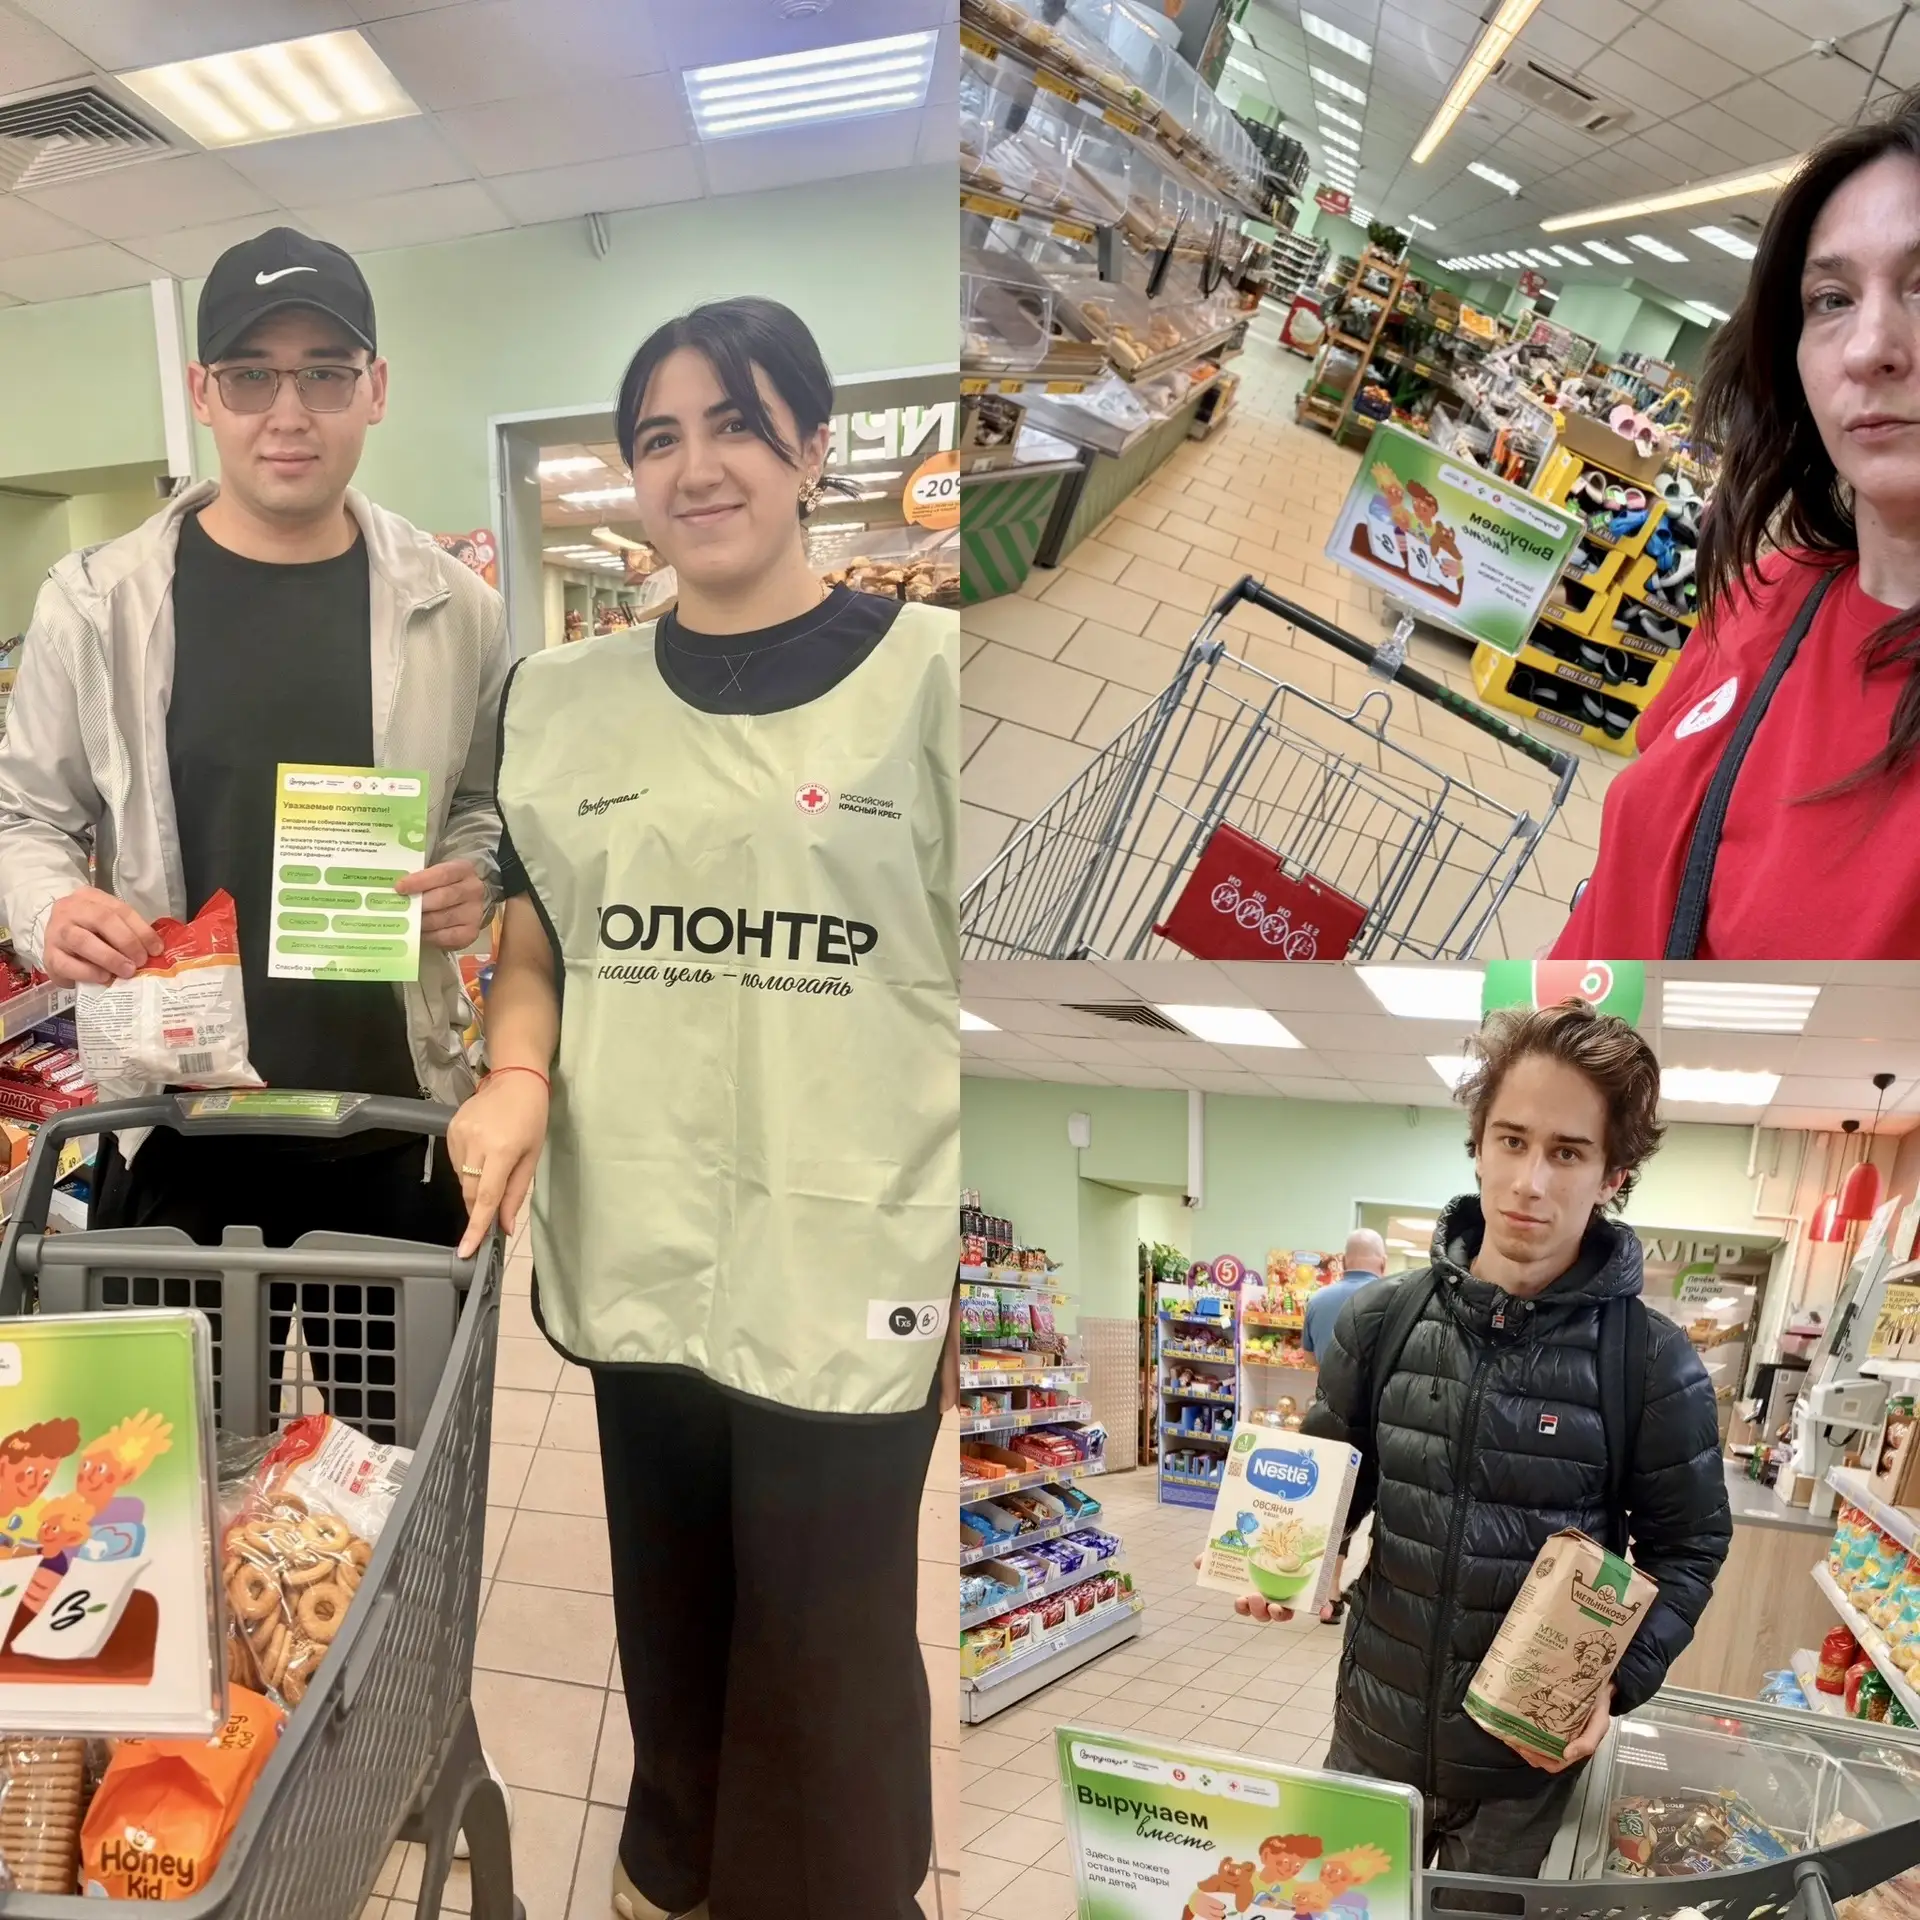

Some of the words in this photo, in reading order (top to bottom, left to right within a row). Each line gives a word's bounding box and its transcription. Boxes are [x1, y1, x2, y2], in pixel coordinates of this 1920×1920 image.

[917, 478, 960, 498] -20
[283, 801, 334, 812] Уважаемые
[335, 804, 390, 815] покупатели!
[578, 789, 640, 817] Выручаем
[839, 803, 877, 815] КРАСНЫЙ
[878, 810, 902, 820] КРЕСТ
[840, 793, 894, 808] РОССИЙСКИЙ
[597, 904, 879, 966] ОЛОНТЕР
[275, 963, 303, 972] Спасибо
[598, 963, 659, 985] наша
[663, 965, 715, 987] цель
[741, 971, 853, 997] помогать
[1252, 1499, 1294, 1516] ОВСЯНАЯ
[1574, 1591, 1627, 1622] МЕЛЬНИКОФФ
[1538, 1623, 1569, 1645] МУКА
[219, 1714, 248, 1750] oney
[1077, 1784, 1209, 1830] Выручаем
[1136, 1815, 1216, 1852] вместе
[100, 1840, 194, 1886] Honey
[1085, 1848, 1114, 1866] Здесь
[1116, 1855, 1130, 1866] вы
[1132, 1859, 1170, 1875] можете
[1087, 1861, 1131, 1879] оставить
[1133, 1870, 1170, 1887] товары
[127, 1874, 162, 1900] Kid
[1088, 1873, 1106, 1884] для
[1107, 1876, 1137, 1891] детей
